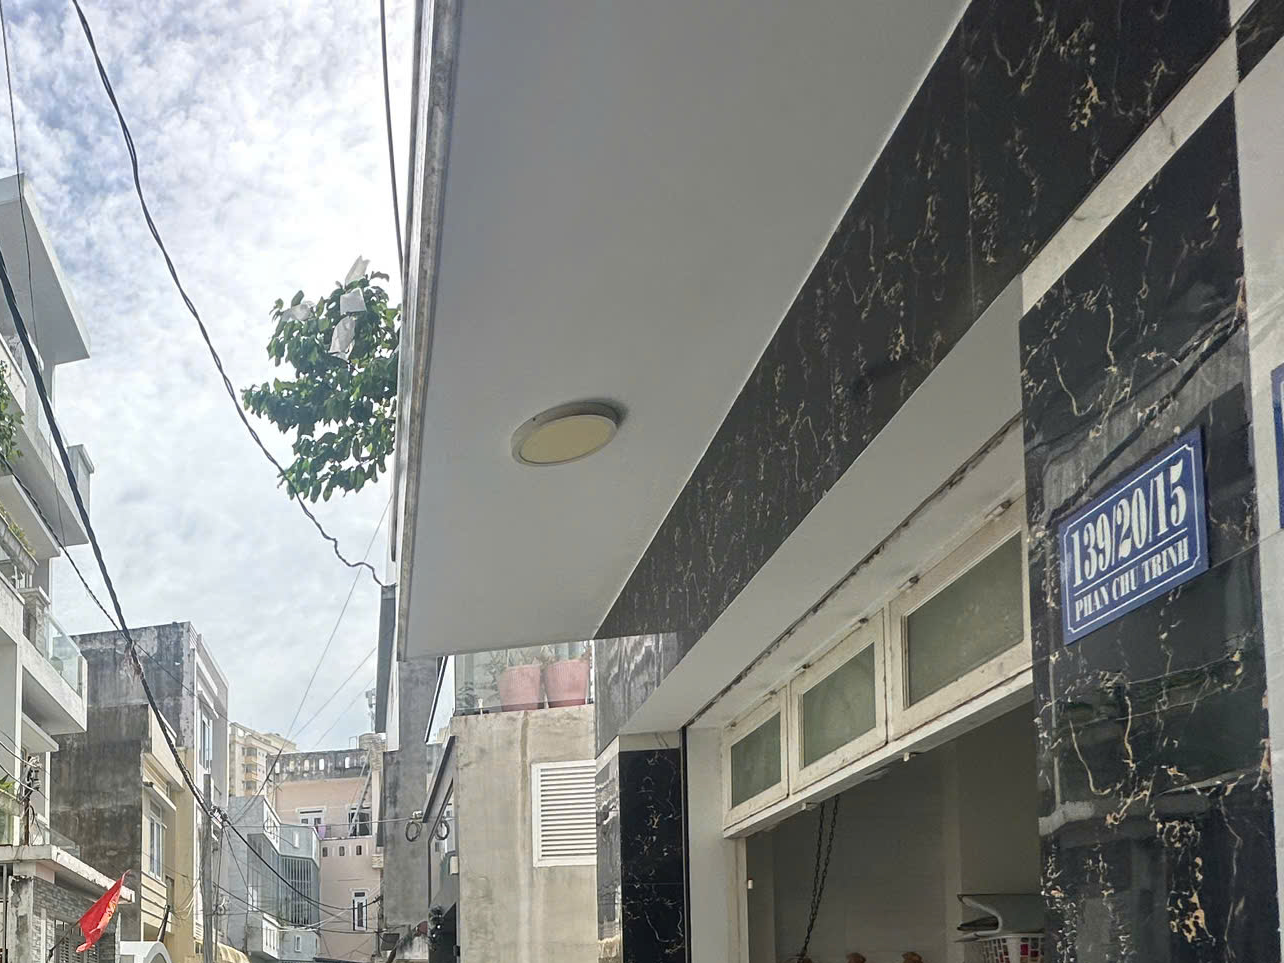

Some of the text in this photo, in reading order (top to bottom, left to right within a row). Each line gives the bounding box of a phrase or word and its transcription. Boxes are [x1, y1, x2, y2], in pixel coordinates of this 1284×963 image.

[1071, 458, 1187, 588] 139/20/15
[1075, 536, 1190, 622] PHAN CHU TRINH
